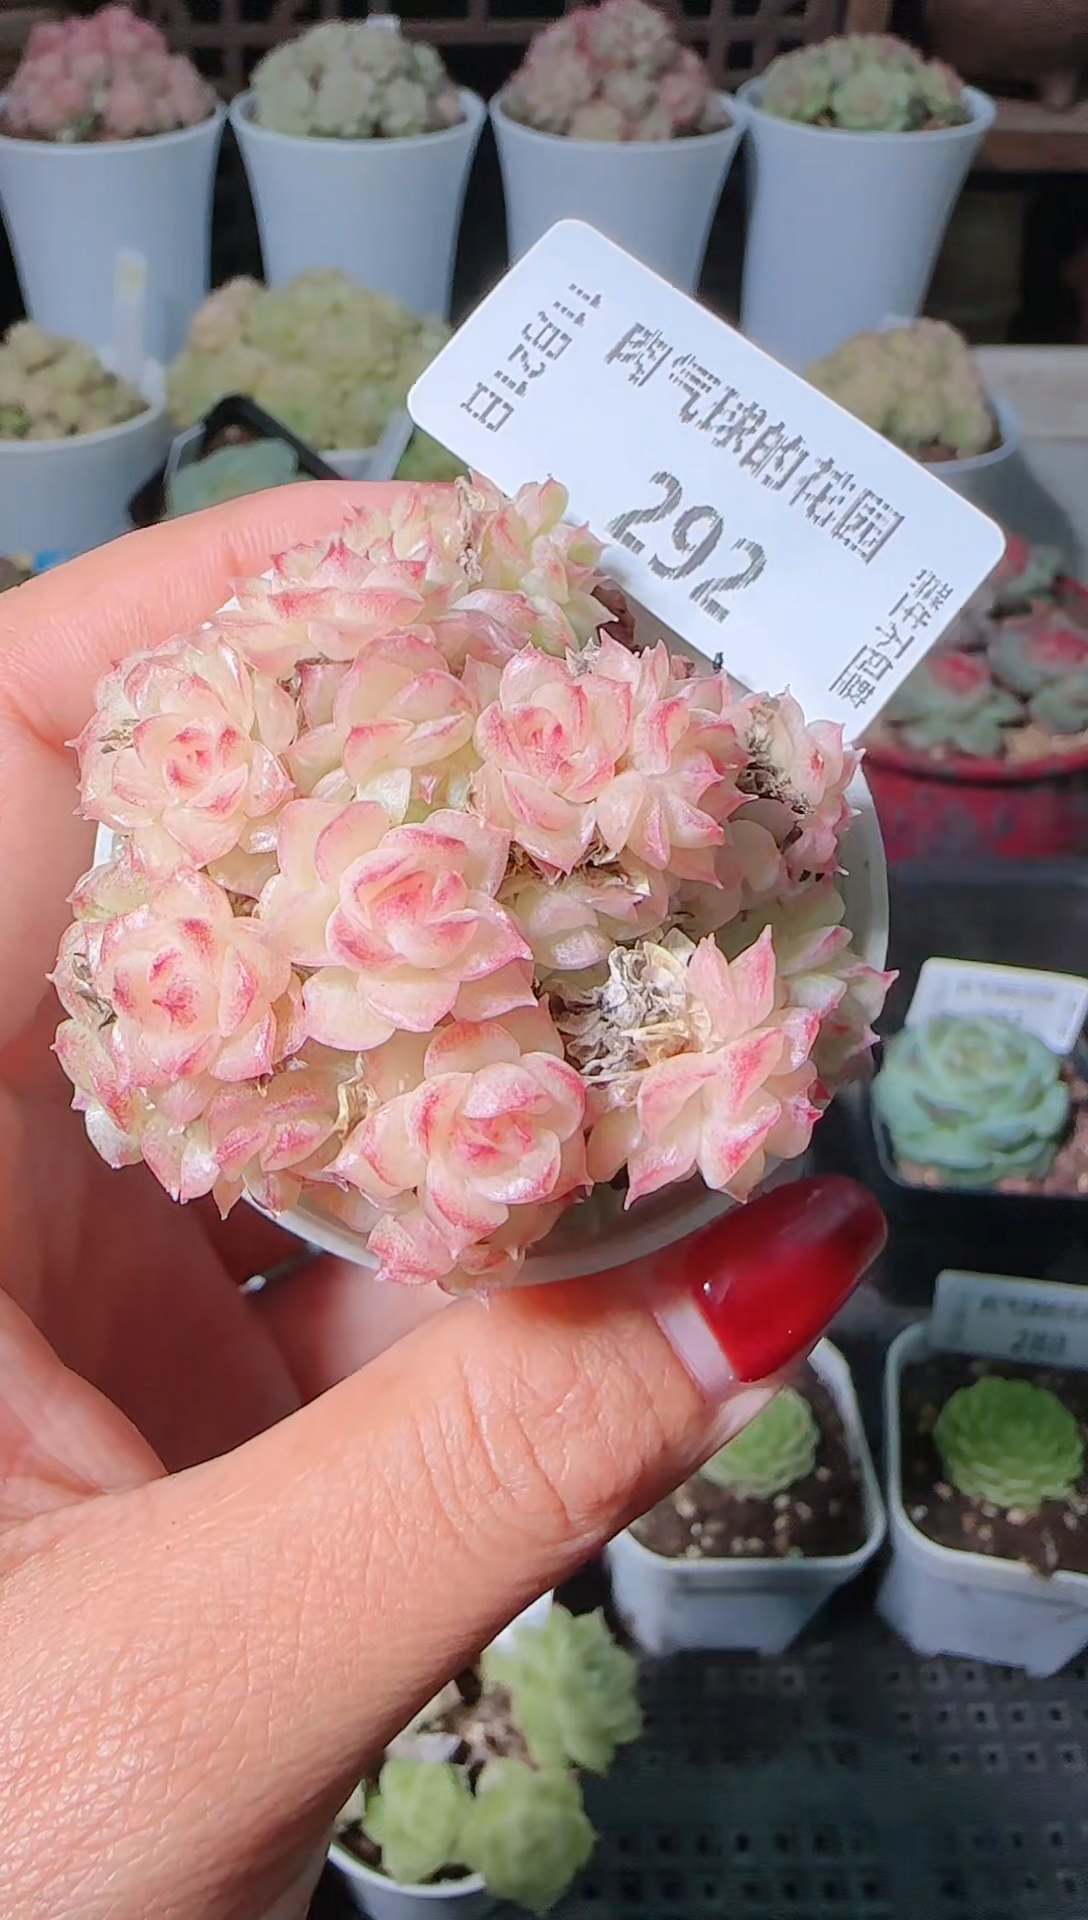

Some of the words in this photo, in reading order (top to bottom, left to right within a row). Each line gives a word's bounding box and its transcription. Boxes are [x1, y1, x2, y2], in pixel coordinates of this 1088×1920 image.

[459, 282, 603, 433] 11月21日
[604, 322, 904, 564] 肉气球的花园
[608, 471, 768, 623] 292
